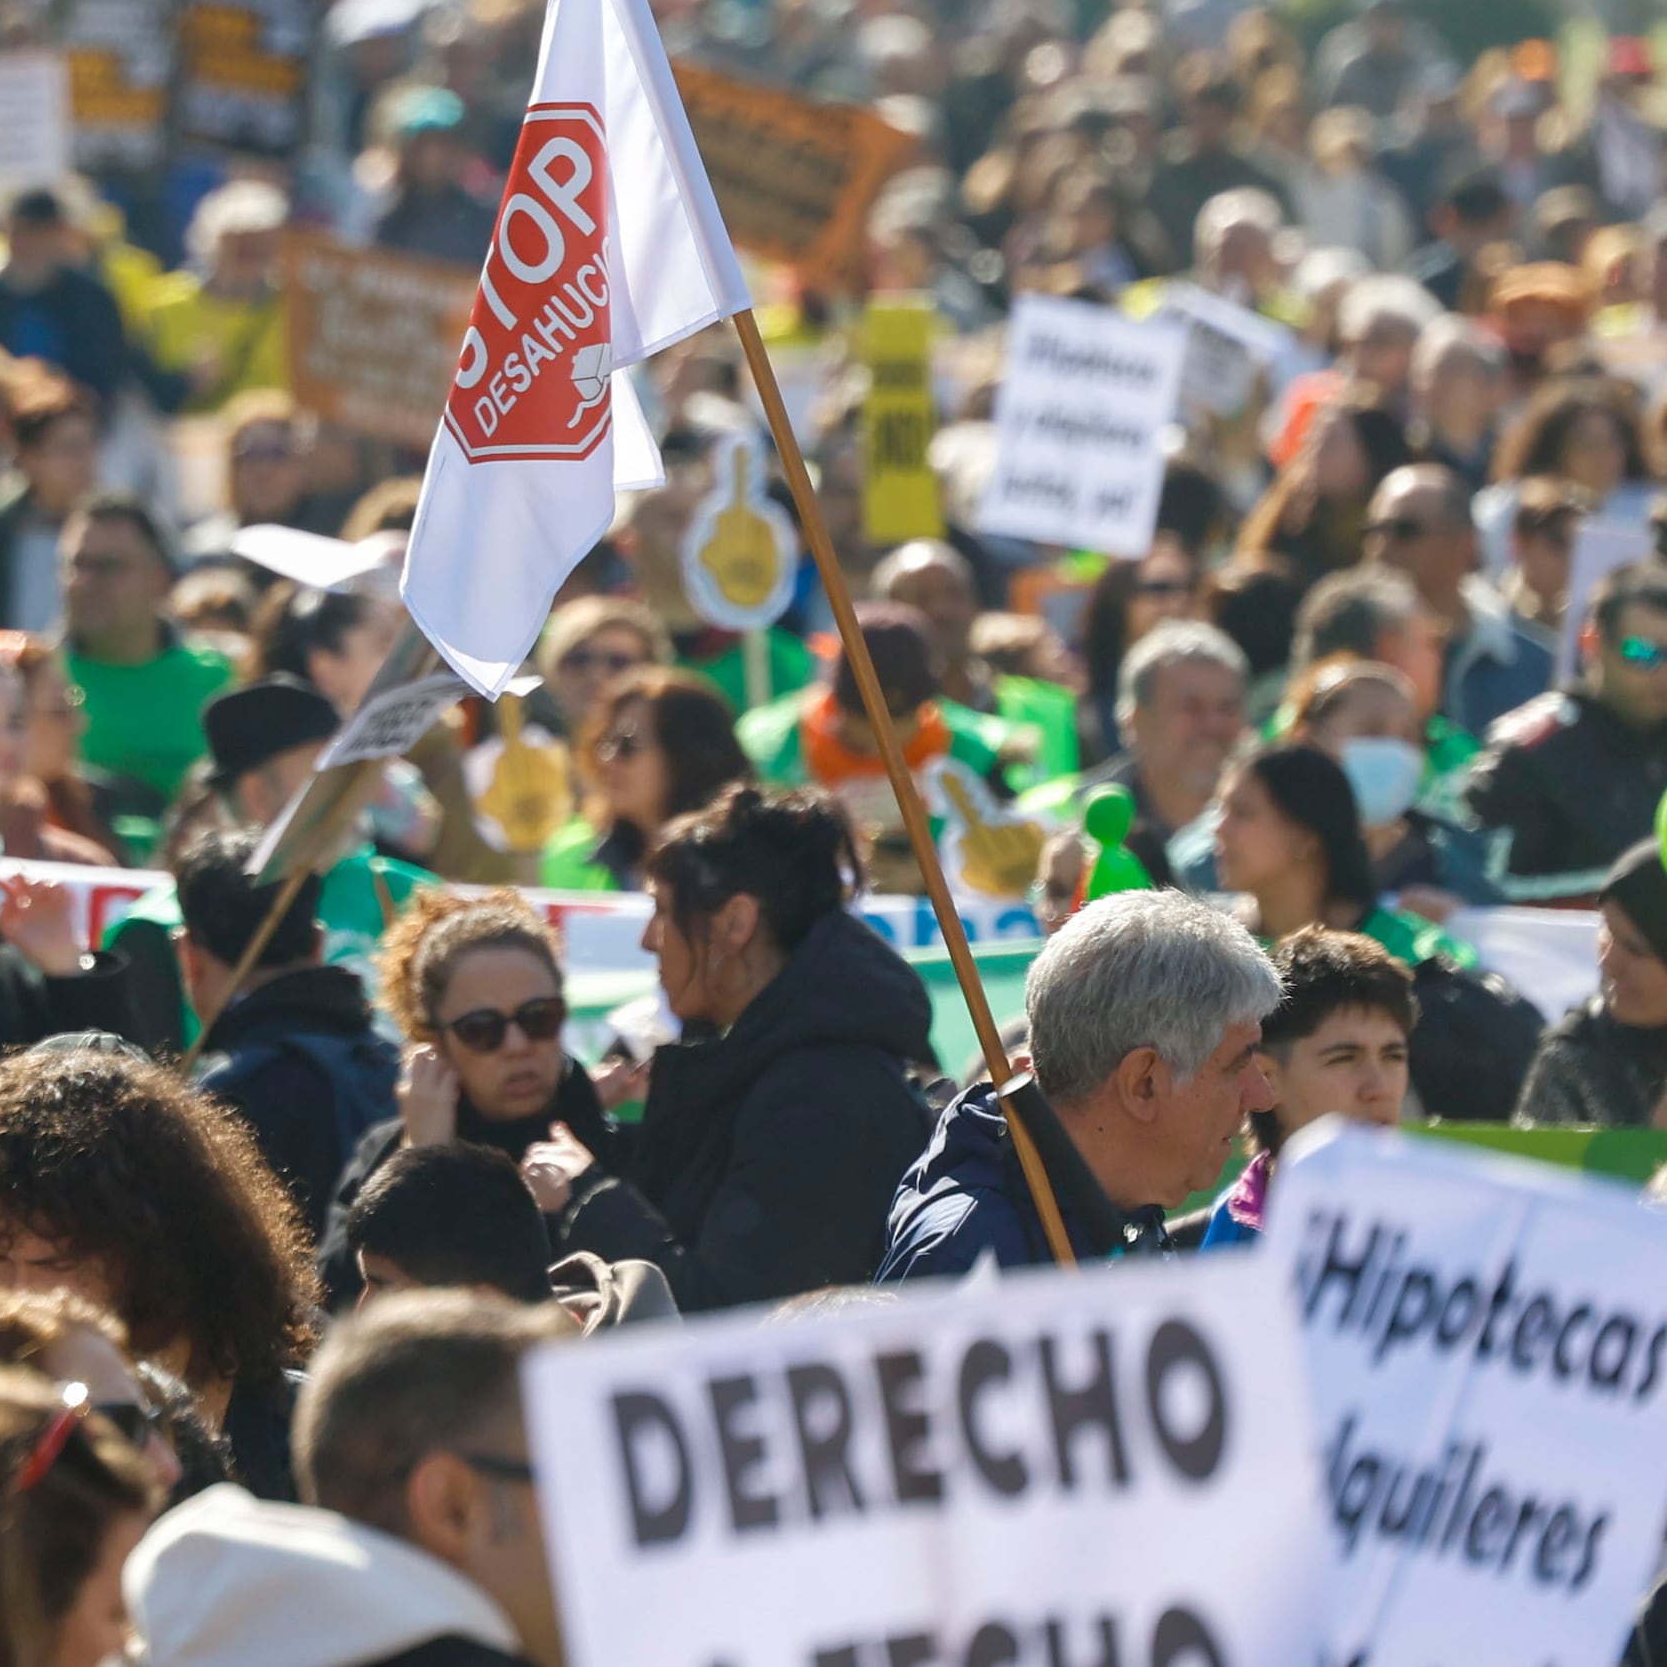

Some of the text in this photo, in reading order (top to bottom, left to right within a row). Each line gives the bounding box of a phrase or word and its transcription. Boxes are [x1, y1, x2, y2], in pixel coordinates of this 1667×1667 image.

[473, 234, 610, 438] DESAHUCI
[609, 1316, 1230, 1548] DERECHO
[1327, 1406, 1609, 1590] lquileres
